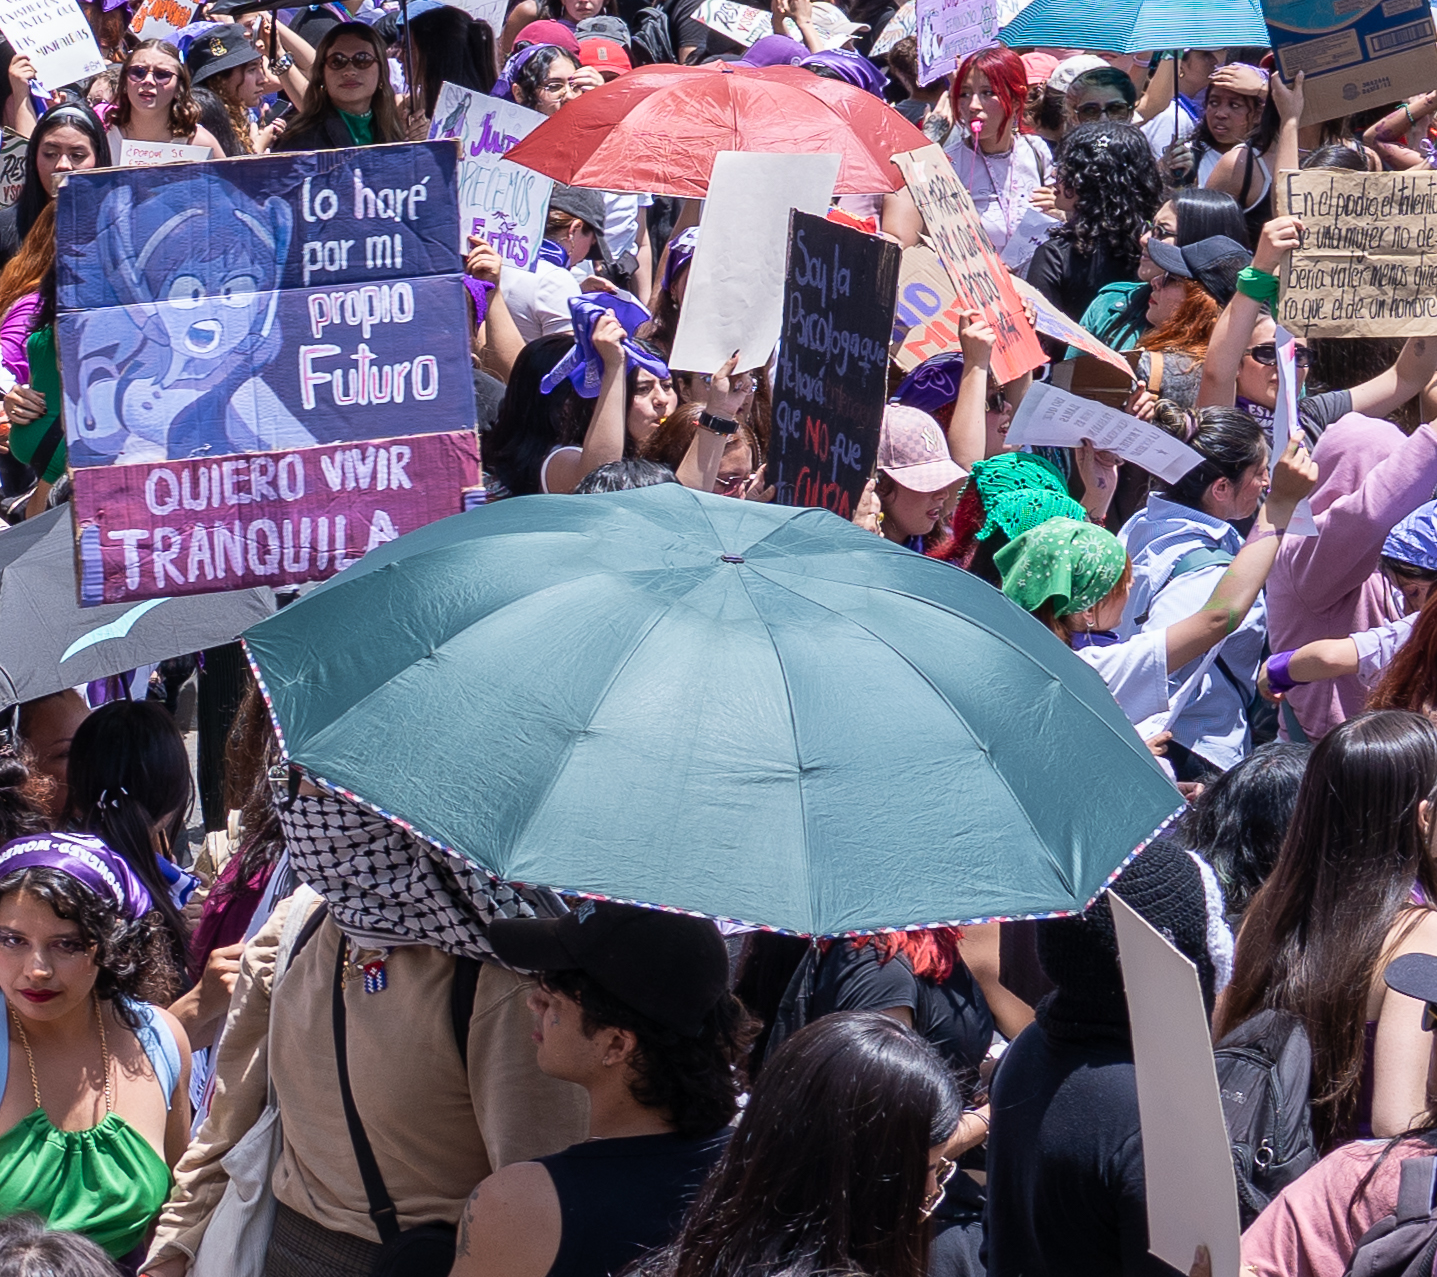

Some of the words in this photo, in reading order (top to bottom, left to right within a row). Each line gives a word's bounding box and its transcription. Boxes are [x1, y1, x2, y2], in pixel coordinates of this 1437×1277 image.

[1286, 173, 1315, 218] En
[1317, 176, 1335, 218] el
[1379, 176, 1397, 218] el
[301, 236, 356, 287] por
[364, 232, 406, 270] mi
[794, 228, 827, 309] Soy
[831, 243, 851, 300] la
[1287, 252, 1327, 292] bería
[1369, 262, 1408, 289] menos
[1315, 224, 1343, 251] una
[1342, 223, 1390, 265] mujer
[1393, 224, 1412, 250] no
[306, 280, 417, 341] propio
[1282, 298, 1299, 322] ro
[1301, 297, 1328, 338] que
[1330, 288, 1346, 321] el
[1344, 288, 1365, 321] de
[1369, 298, 1387, 321] un
[297, 342, 440, 411] Futuro
[775, 399, 802, 456] que
[804, 414, 831, 463] NO
[143, 453, 306, 516] QUIERO
[320, 444, 414, 492] VIVIR
[106, 507, 400, 592] TRANQUILA
